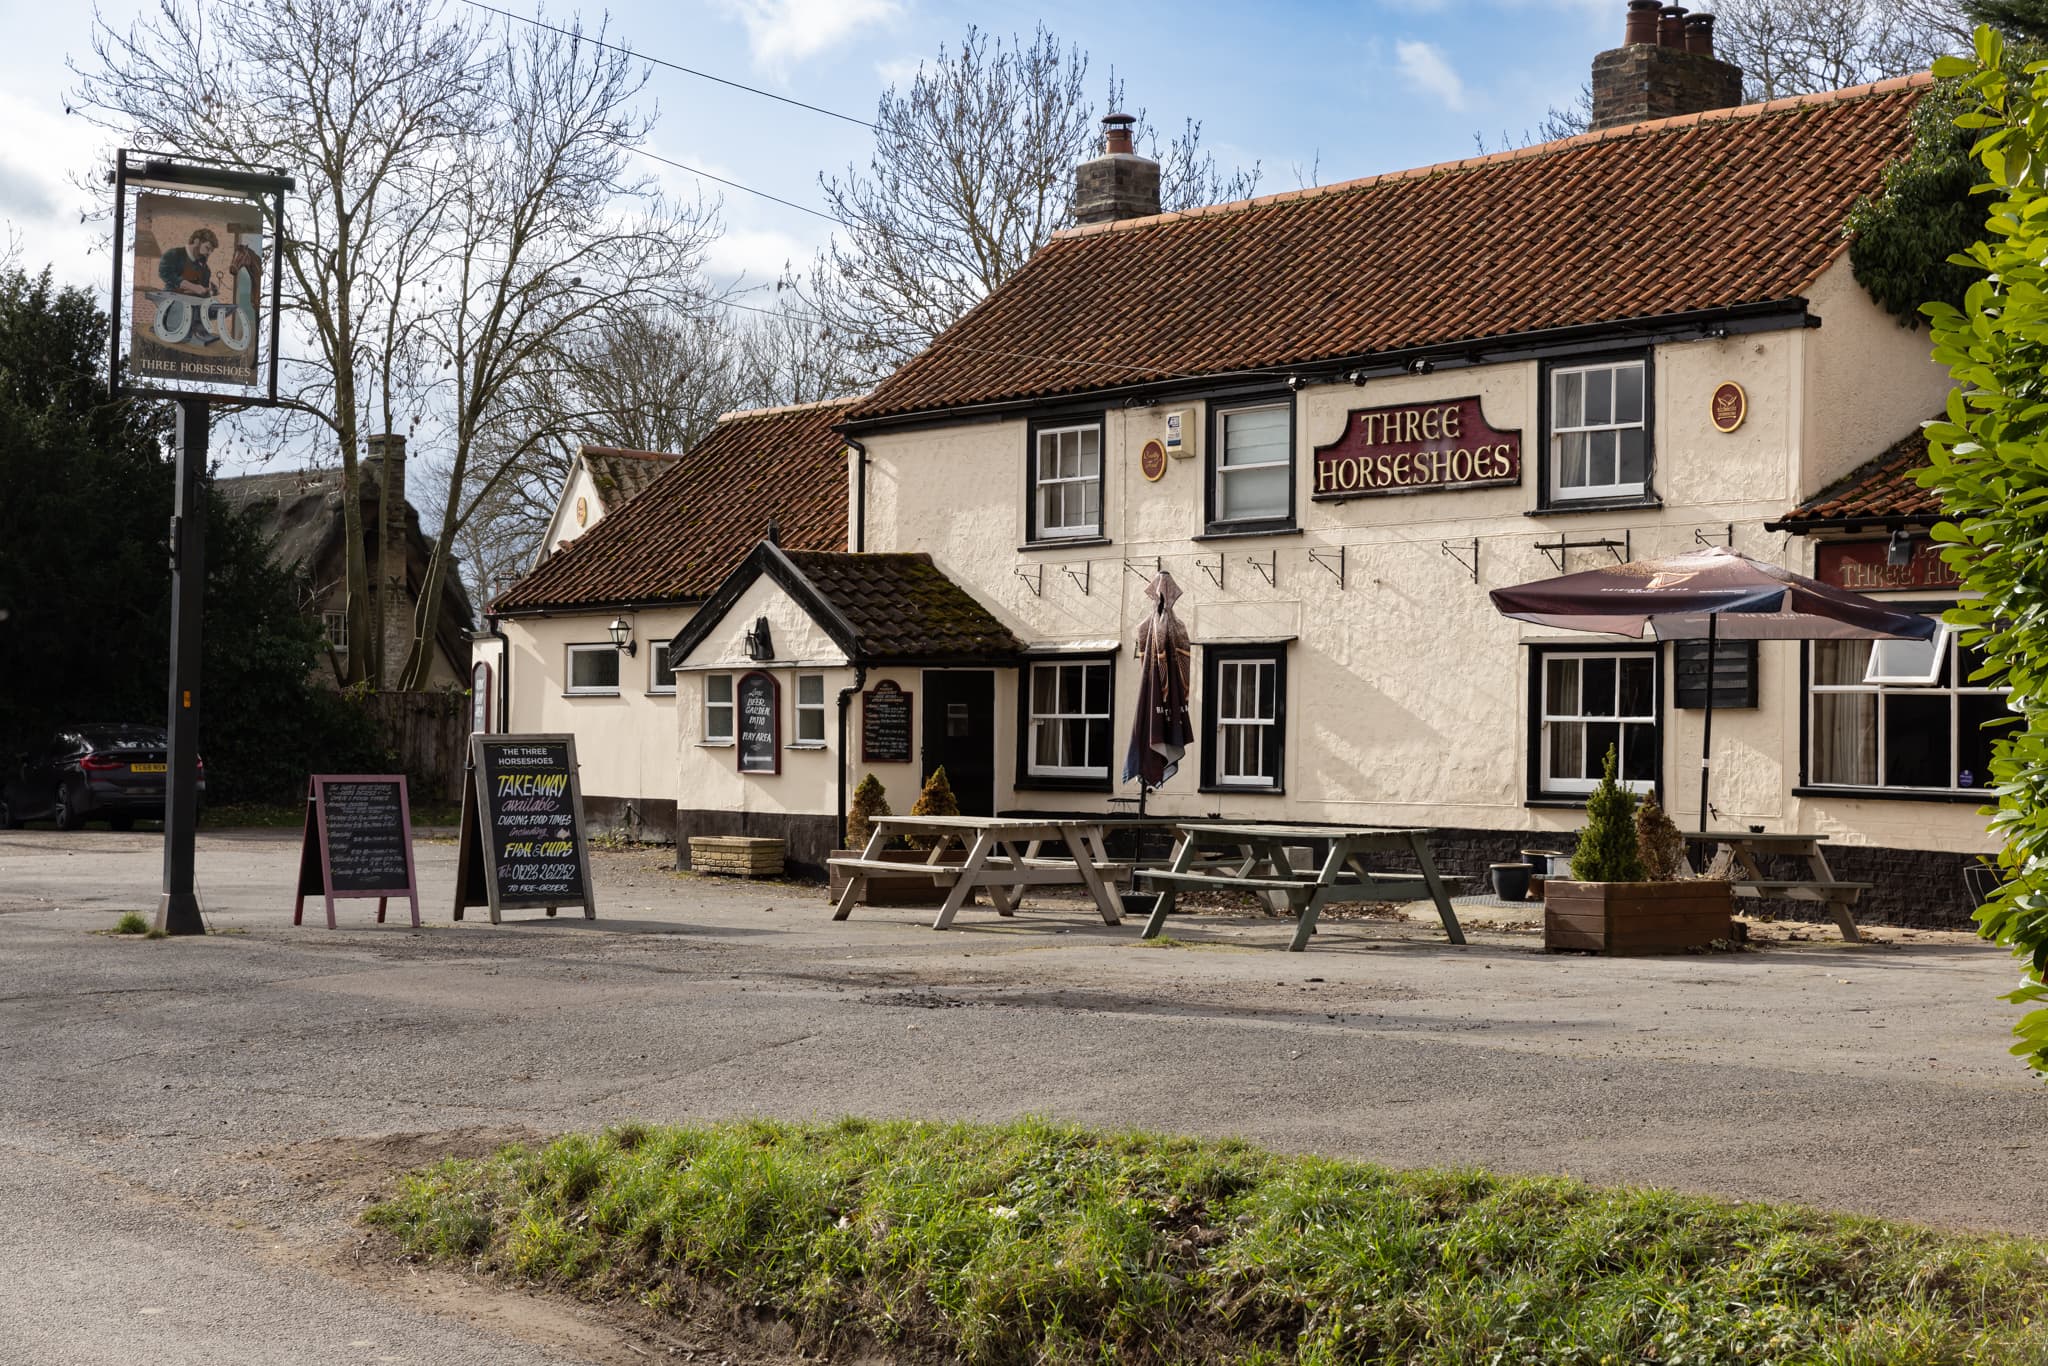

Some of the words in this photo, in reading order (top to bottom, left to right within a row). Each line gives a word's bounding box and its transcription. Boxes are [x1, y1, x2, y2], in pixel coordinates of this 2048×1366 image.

[141, 360, 177, 371] THREE
[181, 362, 251, 377] HORSESHOES
[1360, 406, 1461, 446] THREE
[1318, 444, 1511, 491] HORSESHOES
[1840, 562, 1915, 587] THREE
[745, 706, 771, 716] GARDEN
[748, 716, 766, 726] PATIO
[742, 731, 757, 742] PLAY
[755, 732, 772, 743] AREA
[502, 748, 520, 756] THE
[520, 747, 548, 756] THREE
[498, 757, 554, 766] HORSESHOES
[497, 774, 569, 798] TAKEAWAY
[501, 796, 560, 813] available
[497, 815, 528, 826] DURING
[528, 815, 548, 825] FOOD
[548, 814, 572, 826] TIMES
[503, 842, 533, 858] FISH
[540, 841, 573, 857] CHIPS
[512, 863, 539, 880] 01223
[539, 863, 576, 880] 262252
